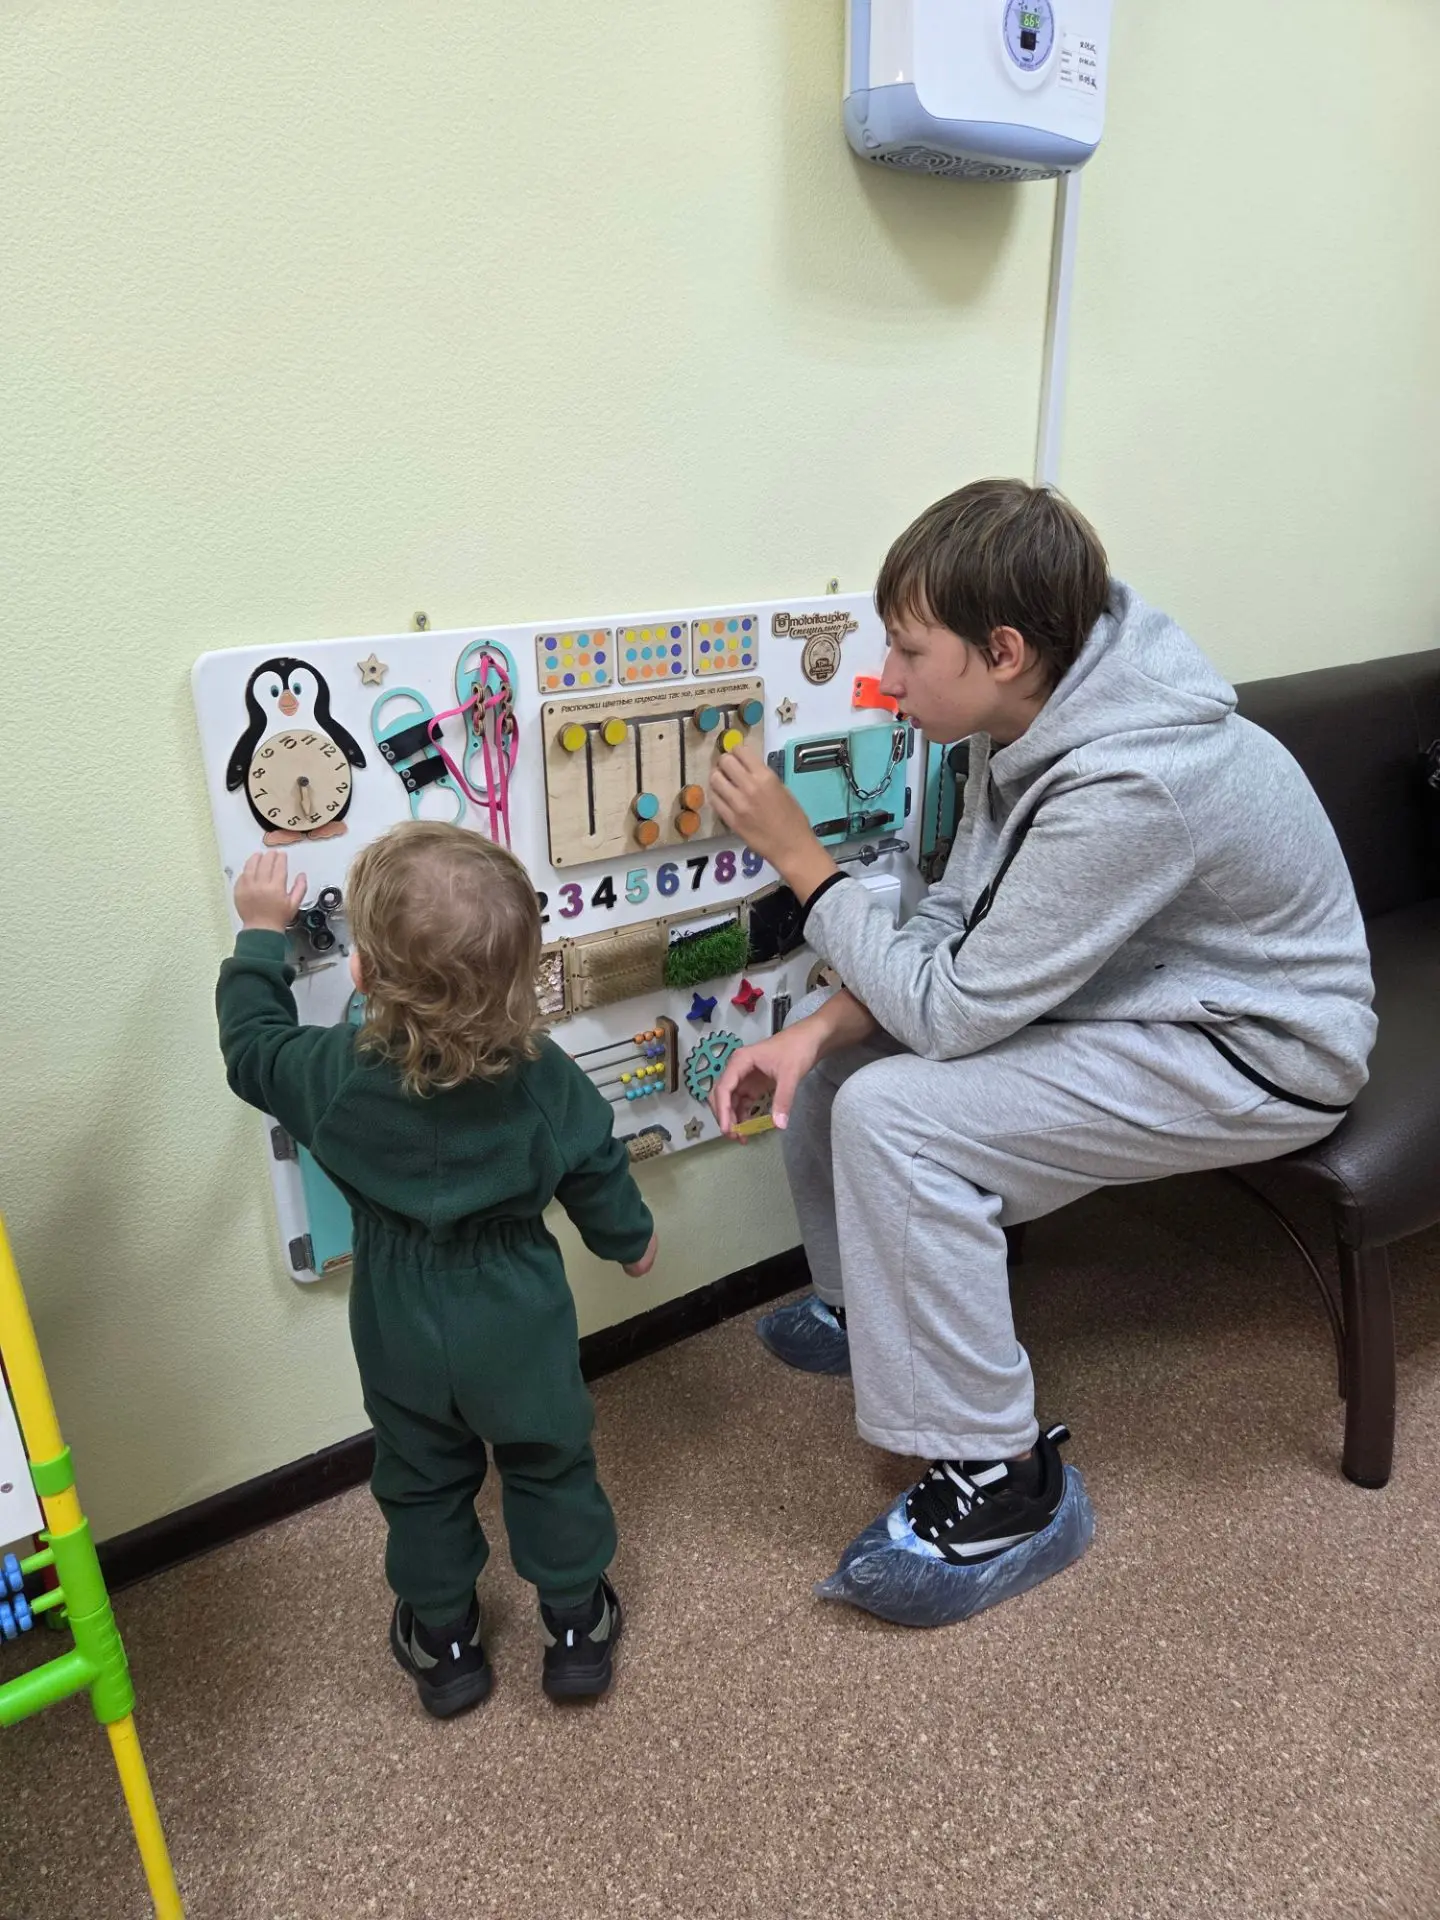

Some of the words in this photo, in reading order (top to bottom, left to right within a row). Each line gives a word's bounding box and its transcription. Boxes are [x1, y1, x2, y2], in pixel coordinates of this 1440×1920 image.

[279, 735, 297, 750] 10
[301, 734, 317, 746] 11
[261, 748, 275, 759] 9
[319, 742, 337, 758] 12
[334, 762, 346, 771] 1
[252, 767, 266, 779] 8
[336, 782, 348, 793] 2
[254, 788, 268, 799] 7
[326, 801, 340, 812] 3
[267, 807, 281, 818] 6
[310, 812, 322, 823] 4
[287, 815, 301, 826] 5
[558, 883, 584, 918] 3
[591, 875, 617, 909] 4
[625, 868, 650, 904] 5
[656, 862, 680, 896] 6
[686, 855, 709, 890] 7
[714, 850, 736, 883] 8
[741, 846, 764, 878] 9
